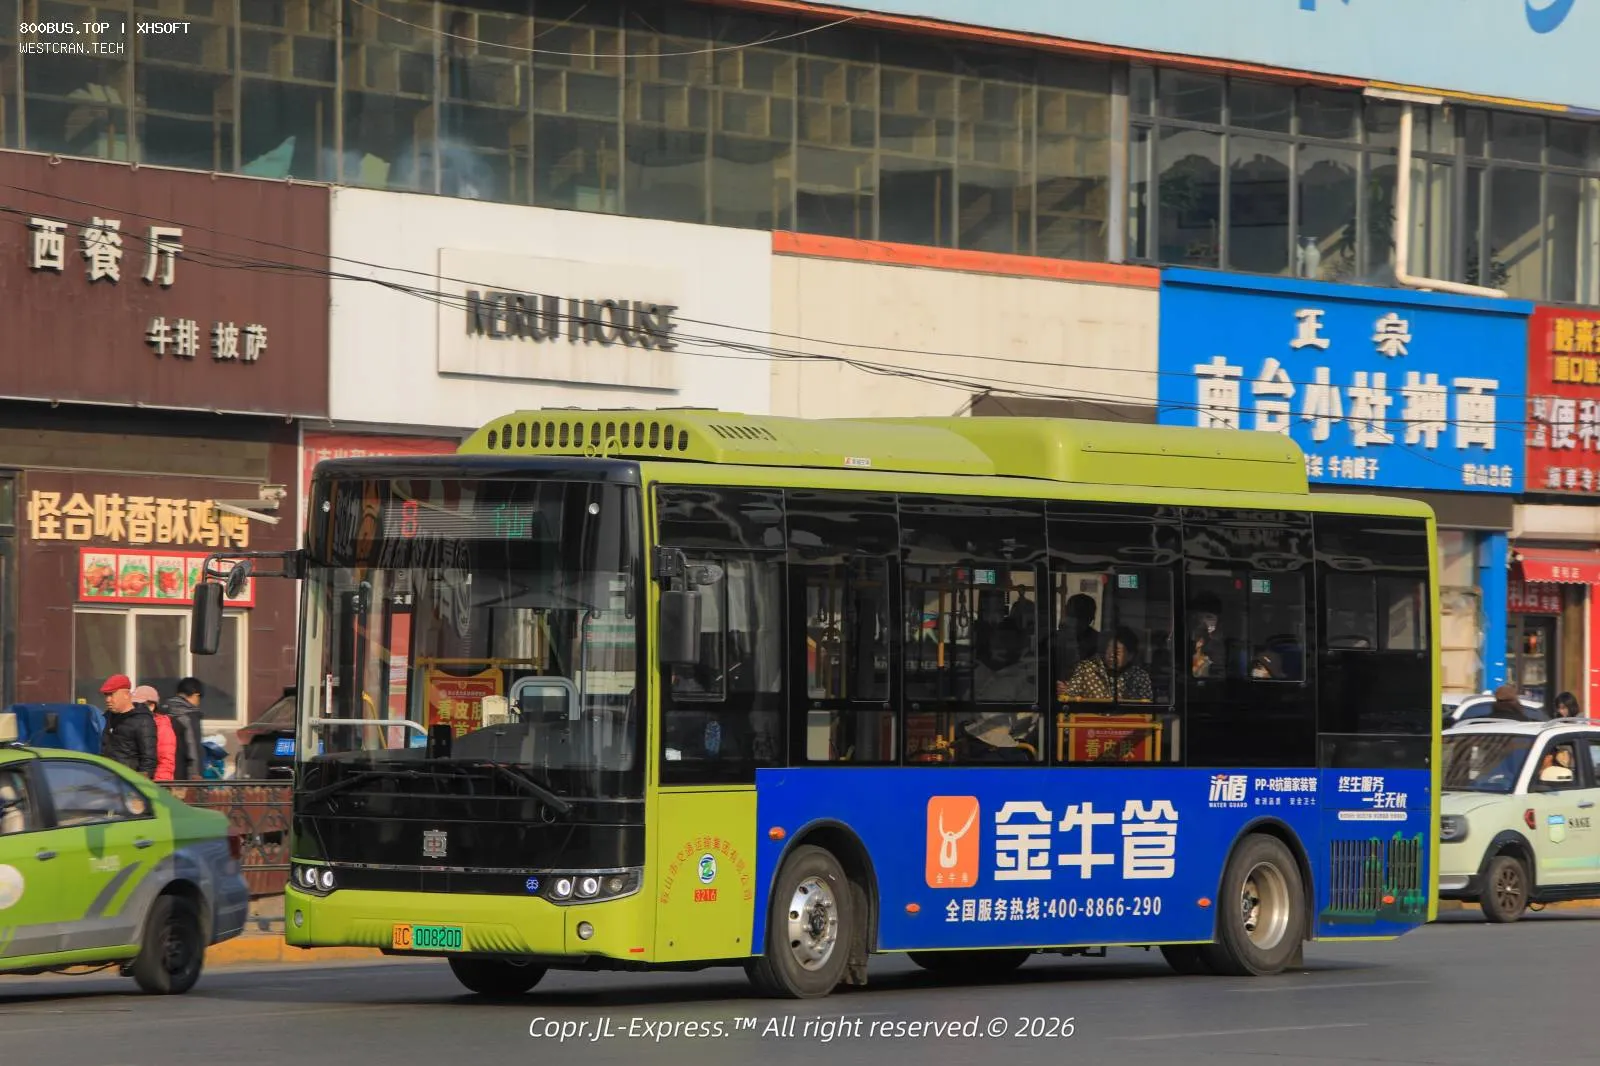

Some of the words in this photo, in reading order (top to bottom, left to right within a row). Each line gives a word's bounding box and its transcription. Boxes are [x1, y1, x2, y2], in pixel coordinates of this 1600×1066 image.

[30, 216, 184, 287] 西餐厅
[149, 316, 200, 357] 牛排
[214, 321, 268, 361] 披萨
[1289, 308, 1412, 358] 正宗
[993, 799, 1179, 881] 金牛管
